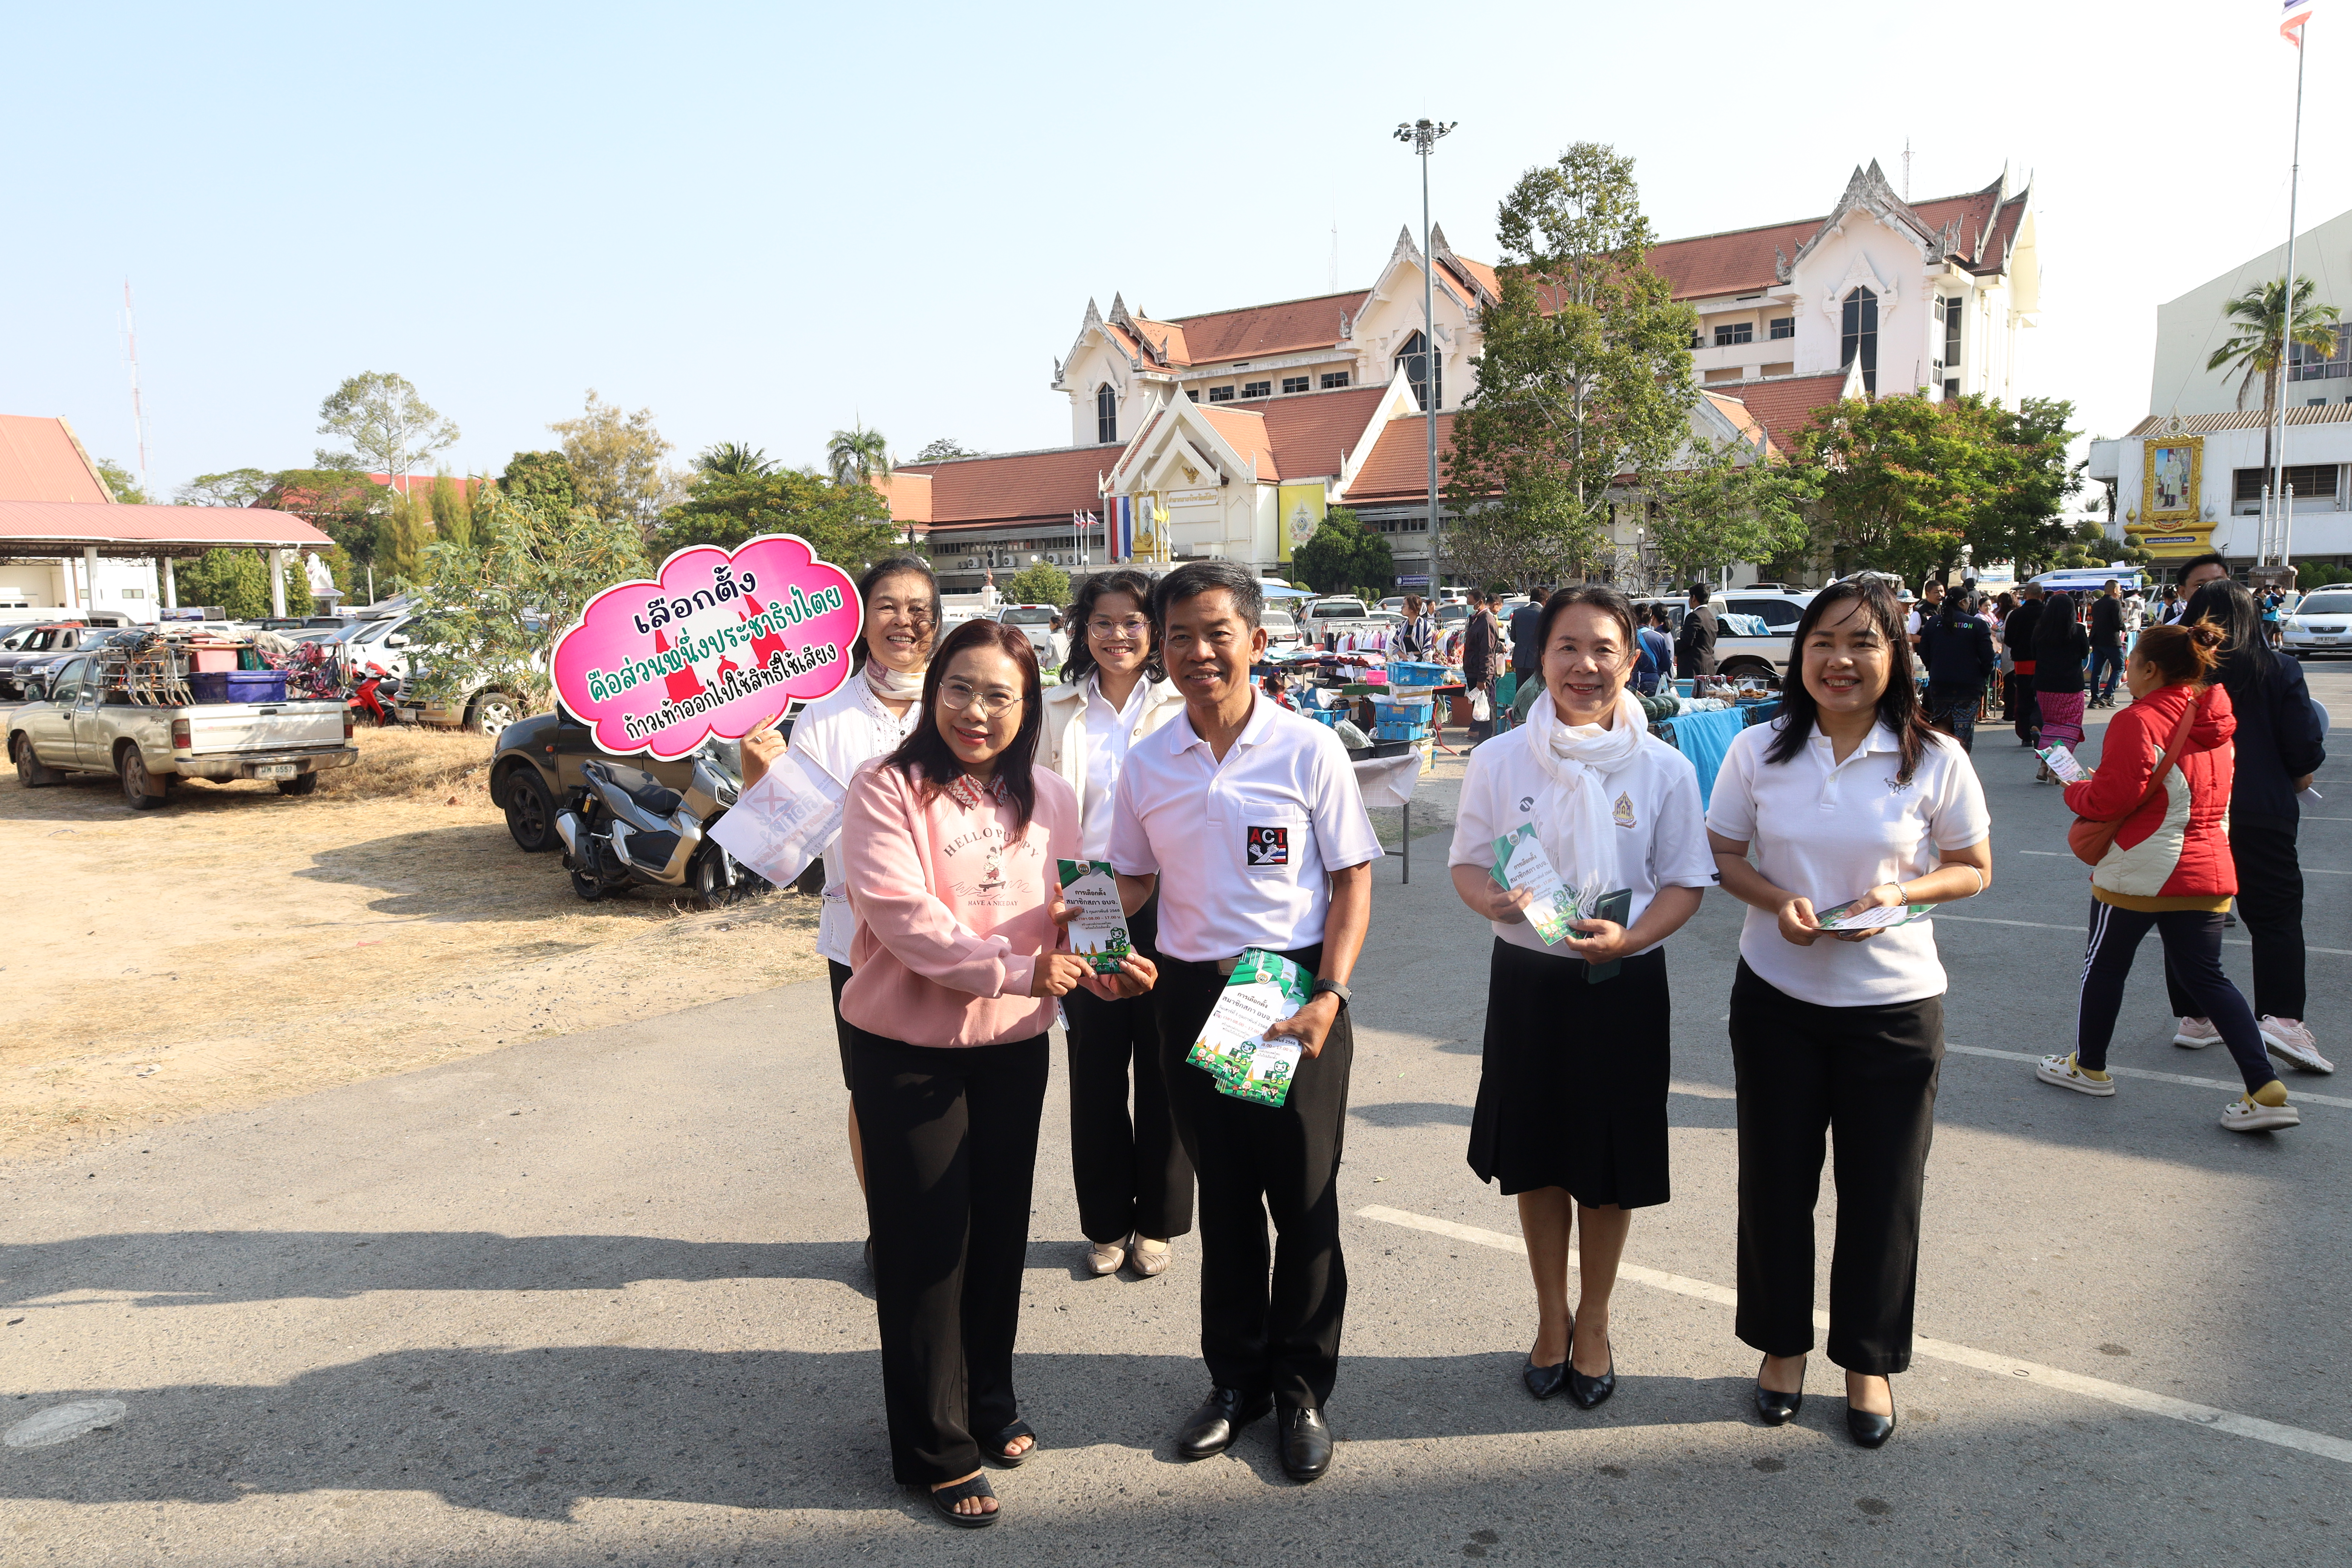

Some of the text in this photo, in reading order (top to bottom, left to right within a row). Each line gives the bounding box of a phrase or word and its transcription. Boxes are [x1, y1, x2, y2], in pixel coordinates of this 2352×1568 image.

[634, 565, 756, 633] เลือกตั้ง
[590, 586, 841, 701] คือส่วนหนึ่งประชาธิปไตย
[943, 828, 1039, 858] HELLO PUPY
[1250, 828, 1286, 844] ACT
[1514, 852, 1537, 870] การเลือกตั้ง
[1510, 867, 1536, 884] สมาชิกสภา
[1222, 996, 1256, 1014] สมาชิกสภา
[1257, 1012, 1271, 1021] อบจ.
[1237, 992, 1268, 1008] การเลือกตั้ง
[1238, 1014, 1258, 1024] กุมภาพันธ์
